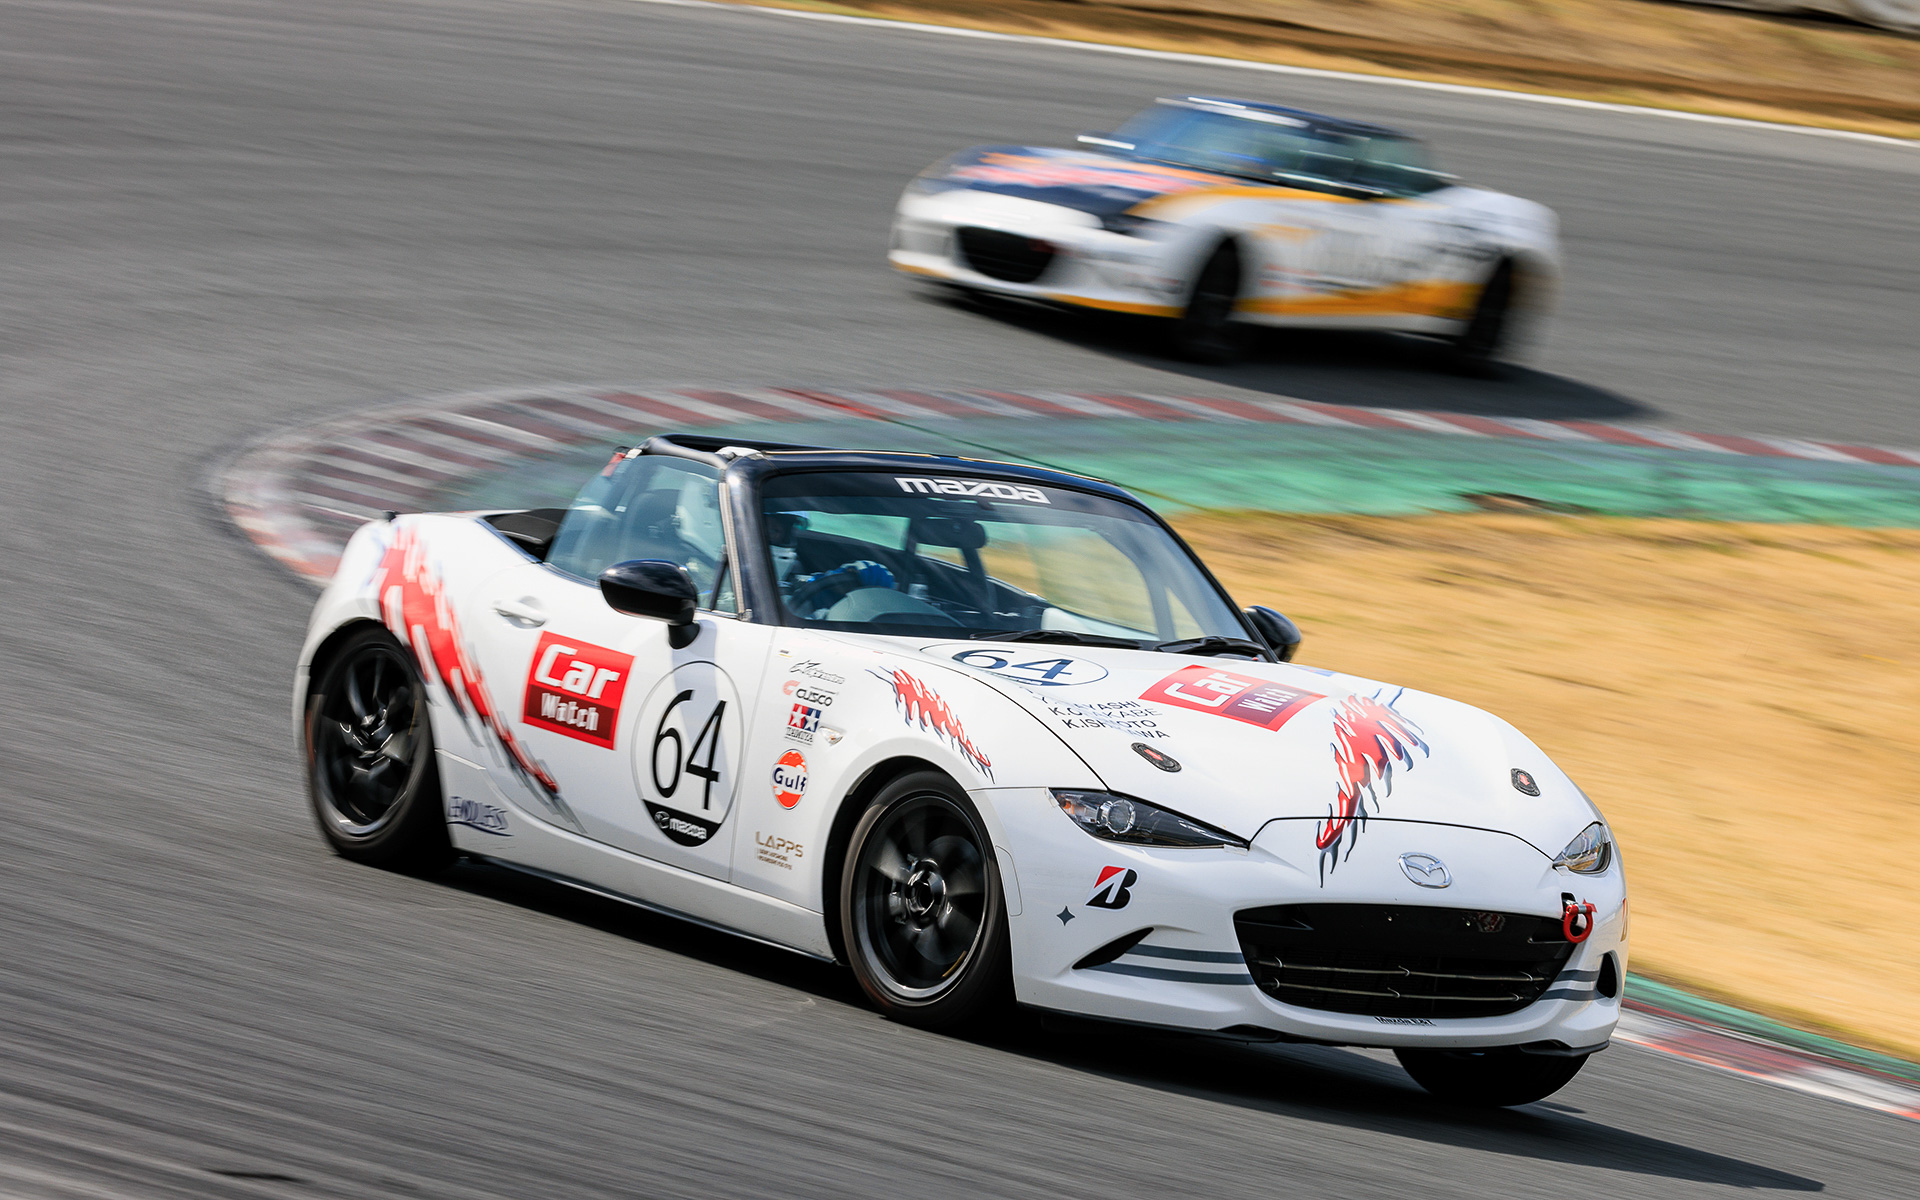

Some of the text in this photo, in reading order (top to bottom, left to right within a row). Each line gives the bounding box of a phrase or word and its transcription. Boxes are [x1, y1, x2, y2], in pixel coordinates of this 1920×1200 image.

[894, 477, 1052, 504] mazda
[535, 643, 621, 699] Car
[952, 649, 1074, 680] 64
[796, 688, 833, 707] CUSCO
[1163, 672, 1254, 708] Car
[1237, 687, 1299, 713] Watch
[541, 692, 599, 731] Watch
[652, 689, 727, 811] 64
[773, 766, 807, 792] Gulf
[755, 831, 804, 858] LAPPS
